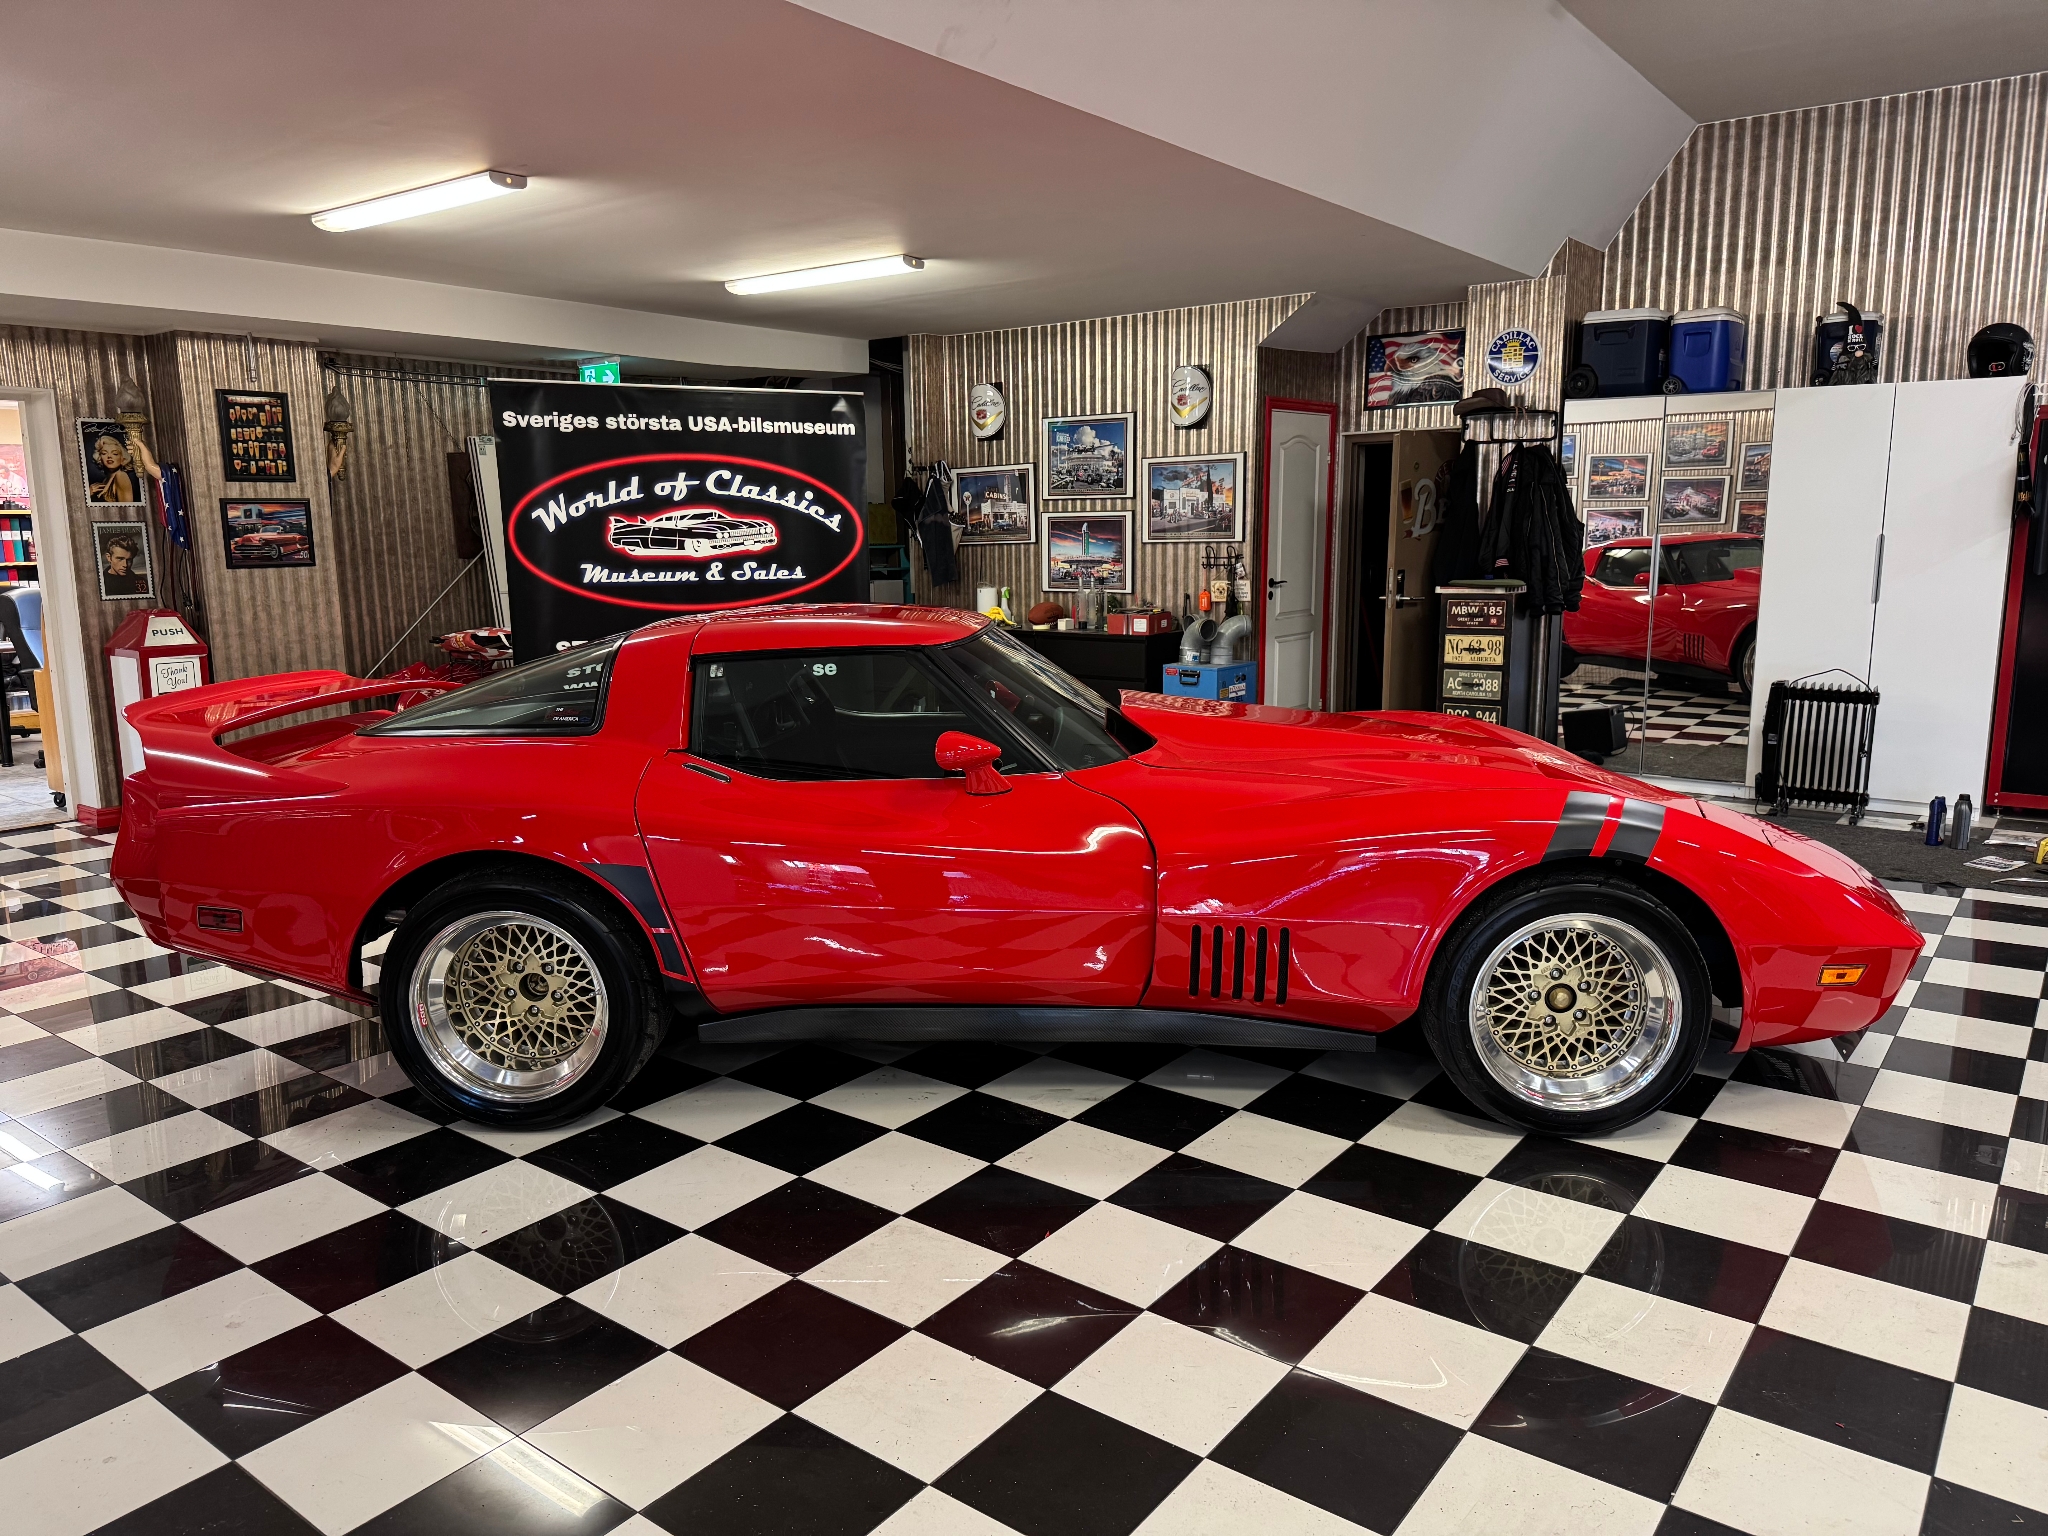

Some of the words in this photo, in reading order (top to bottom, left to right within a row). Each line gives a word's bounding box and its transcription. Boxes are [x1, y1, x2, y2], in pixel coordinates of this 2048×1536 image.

[1490, 331, 1535, 351] CADILLAC
[1493, 368, 1531, 382] SERVICE
[502, 411, 600, 432] Sveriges
[605, 414, 682, 431] största
[688, 416, 856, 435] USA-bilsmuseum
[531, 475, 645, 533] World
[653, 472, 700, 501] of
[705, 469, 842, 532] Classics
[580, 563, 700, 584] Museum
[705, 562, 725, 581] &
[731, 562, 806, 581] Sales
[135, 583, 147, 592] 32
[1483, 606, 1503, 615] 185
[152, 628, 184, 636] PUSH
[160, 664, 188, 679] Thank
[166, 674, 188, 689] You!
[1447, 677, 1463, 689] AC
